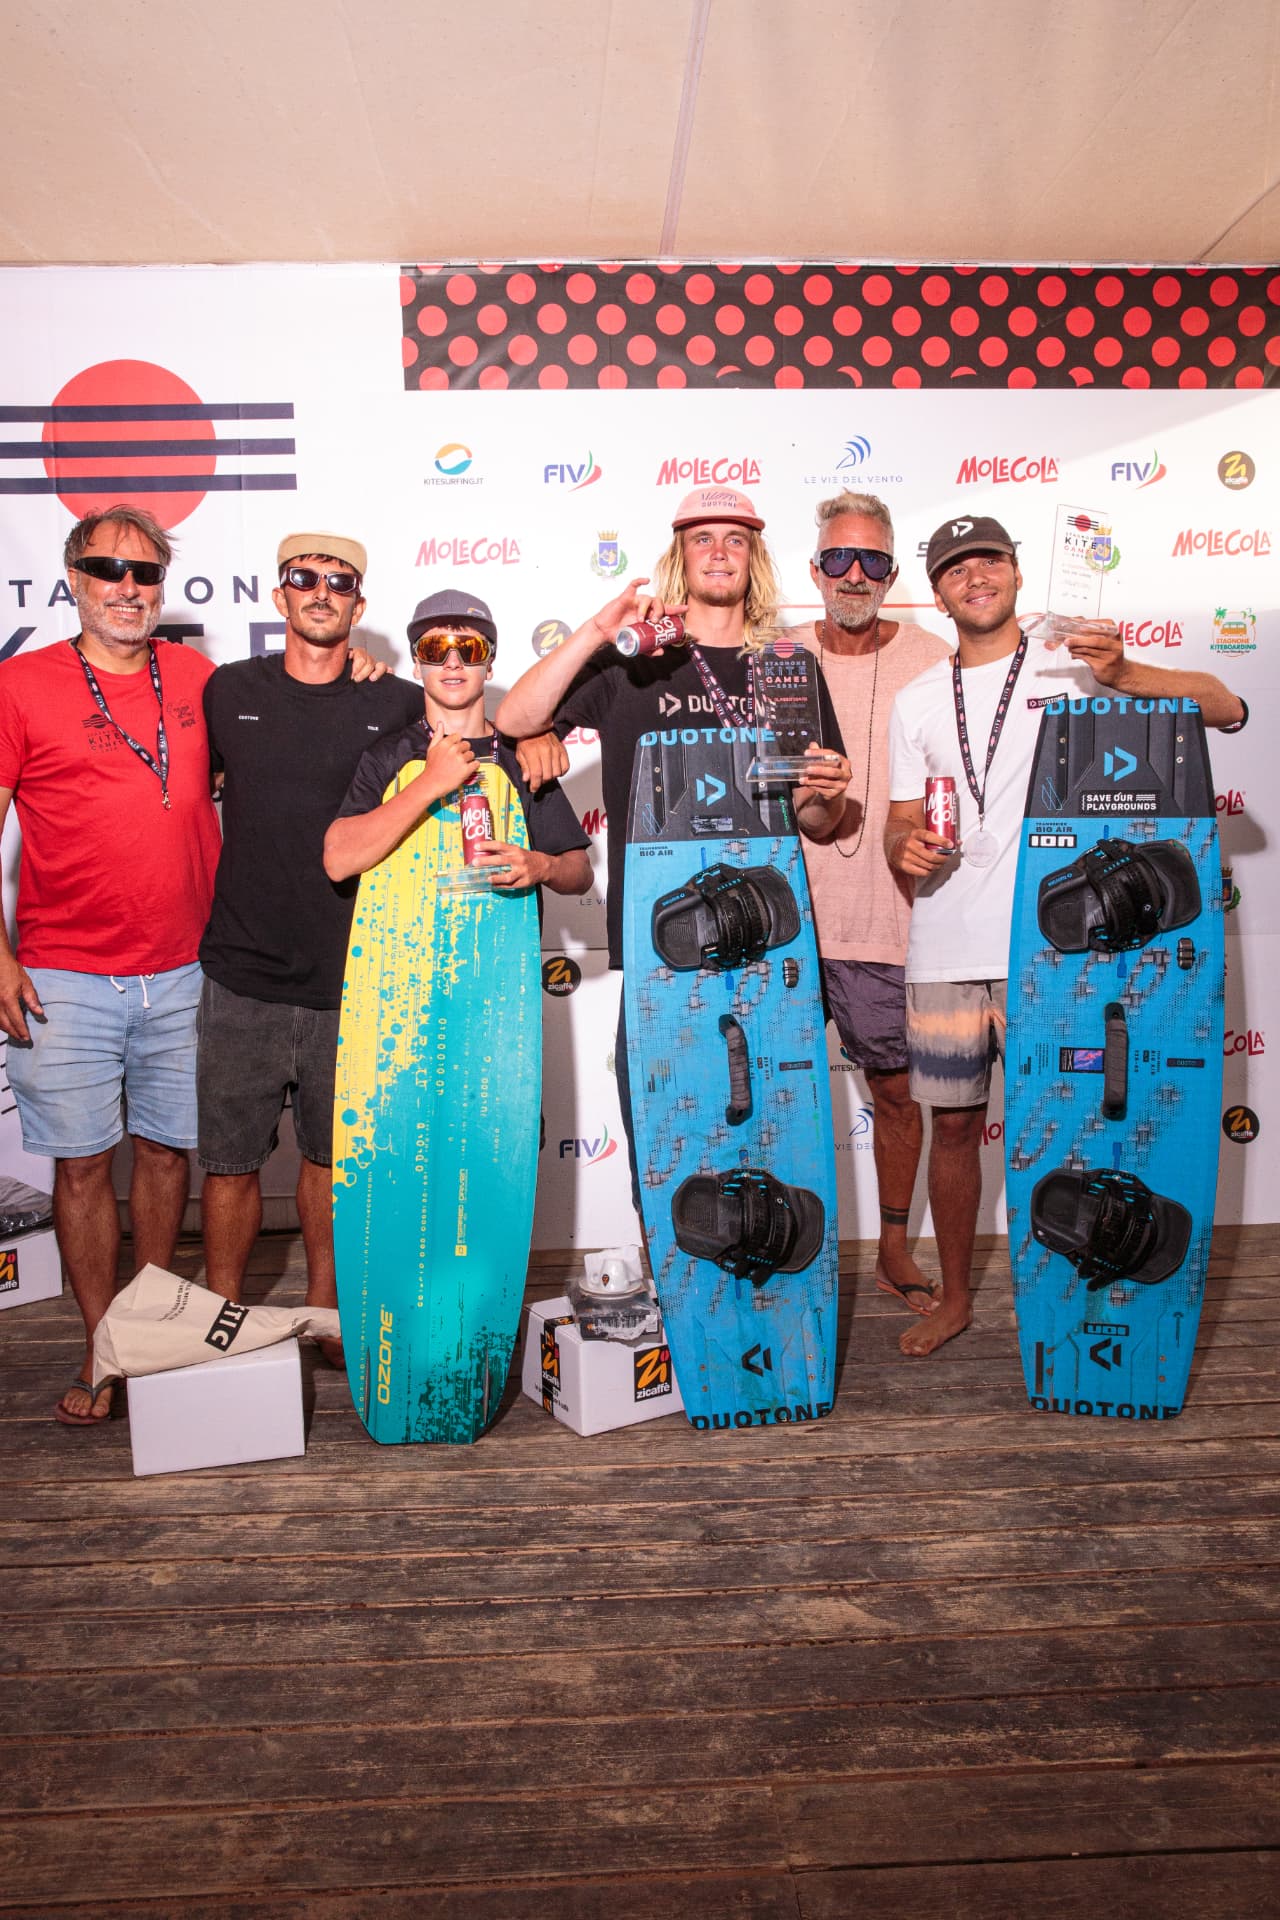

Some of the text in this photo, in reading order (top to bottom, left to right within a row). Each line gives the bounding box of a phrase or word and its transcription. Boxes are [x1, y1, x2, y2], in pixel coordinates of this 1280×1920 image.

[544, 464, 586, 484] FIV
[804, 475, 903, 484] LE VIE DEL VENTO
[1111, 463, 1151, 482] FIV
[1065, 537, 1097, 549] KITE
[765, 666, 807, 675] KITE
[1046, 697, 1200, 715] DUOTONE
[640, 728, 776, 746] DUOTONE
[1086, 794, 1111, 802] SAVE
[1113, 792, 1133, 802] OUR
[1086, 803, 1157, 811] PLAYGROUNDS
[931, 810, 957, 825] COL
[465, 822, 493, 841] COL
[559, 1138, 601, 1158] FIV
[377, 1309, 393, 1404] OZONE
[636, 1382, 671, 1399] zicaffè
[692, 1401, 830, 1429] DUOTONE
[1031, 1396, 1180, 1421] DUOTONE
